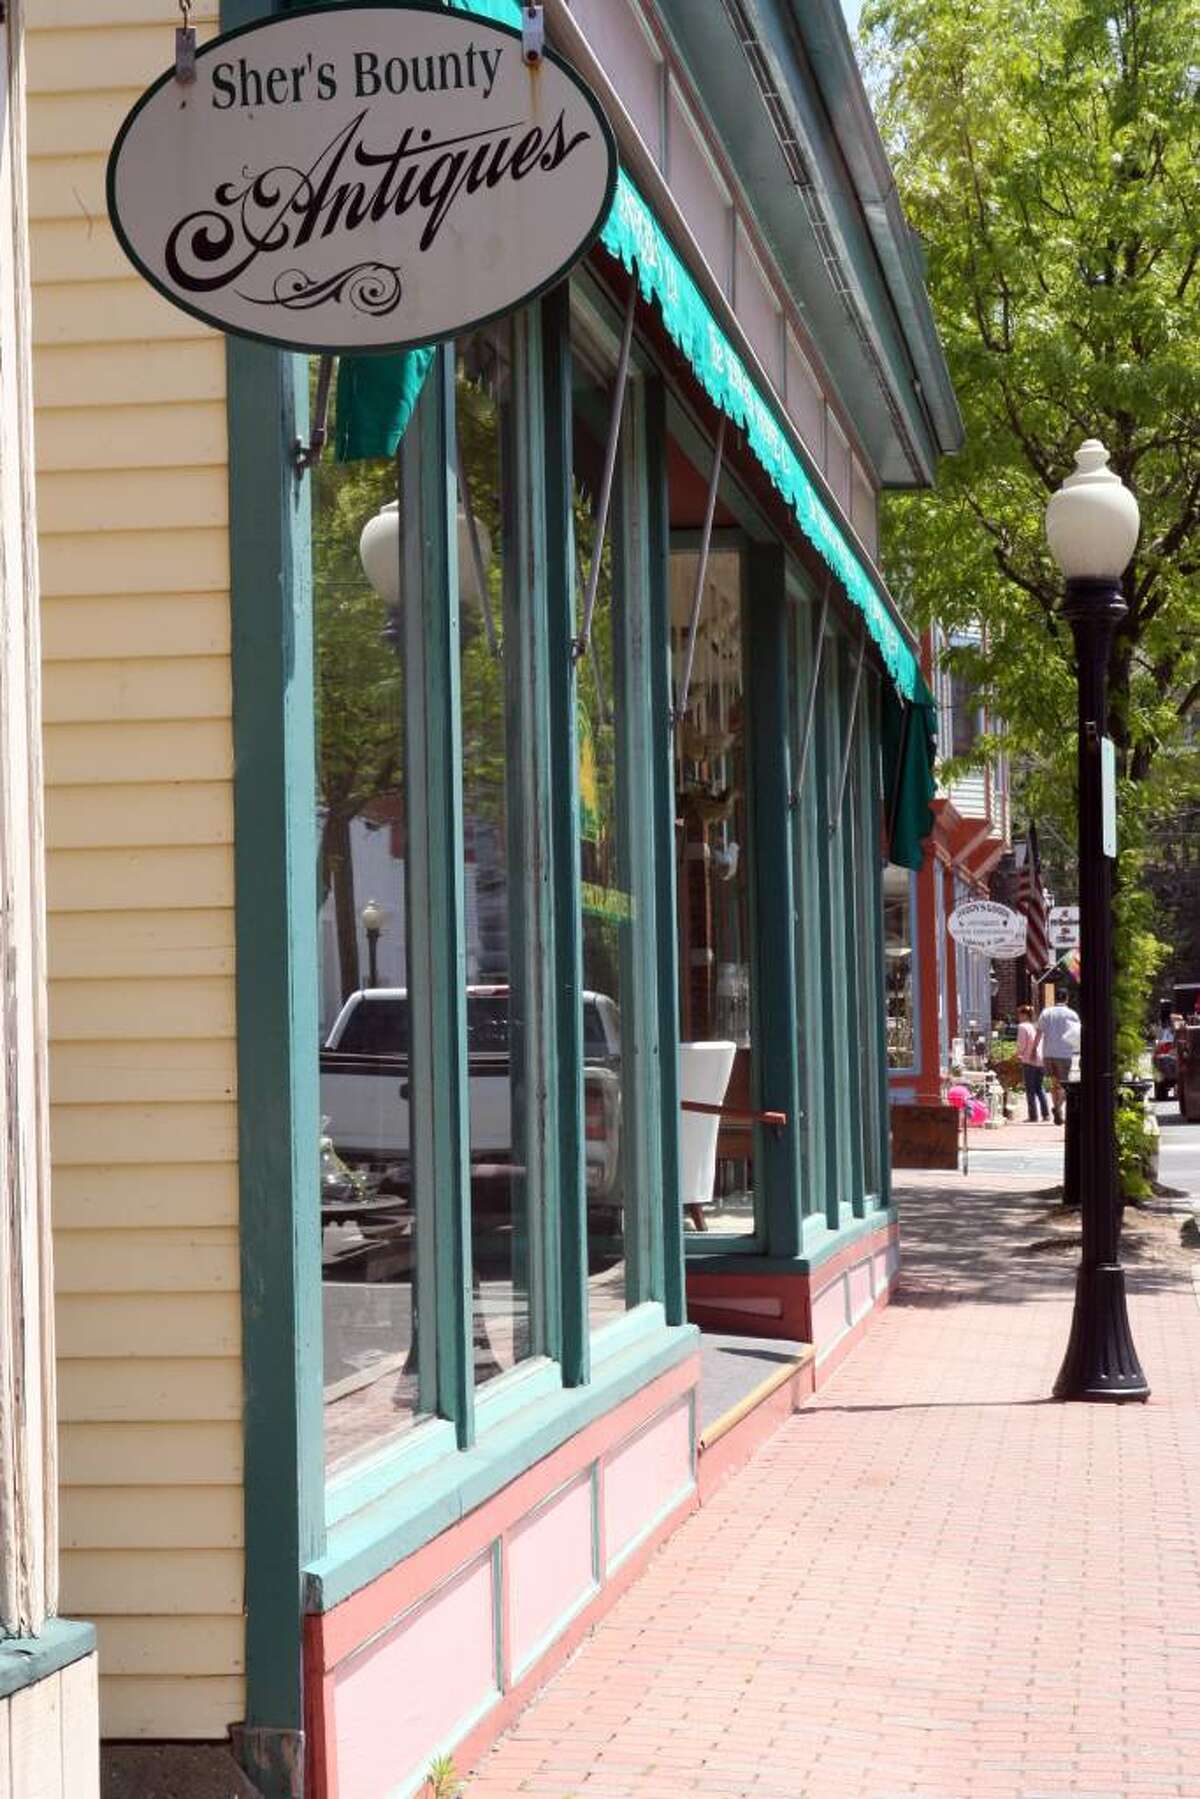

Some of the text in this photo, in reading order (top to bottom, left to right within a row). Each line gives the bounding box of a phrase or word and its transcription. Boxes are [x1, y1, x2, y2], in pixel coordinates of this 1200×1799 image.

[211, 42, 504, 110] Sher's Bounty
[164, 107, 591, 293] Antiques
